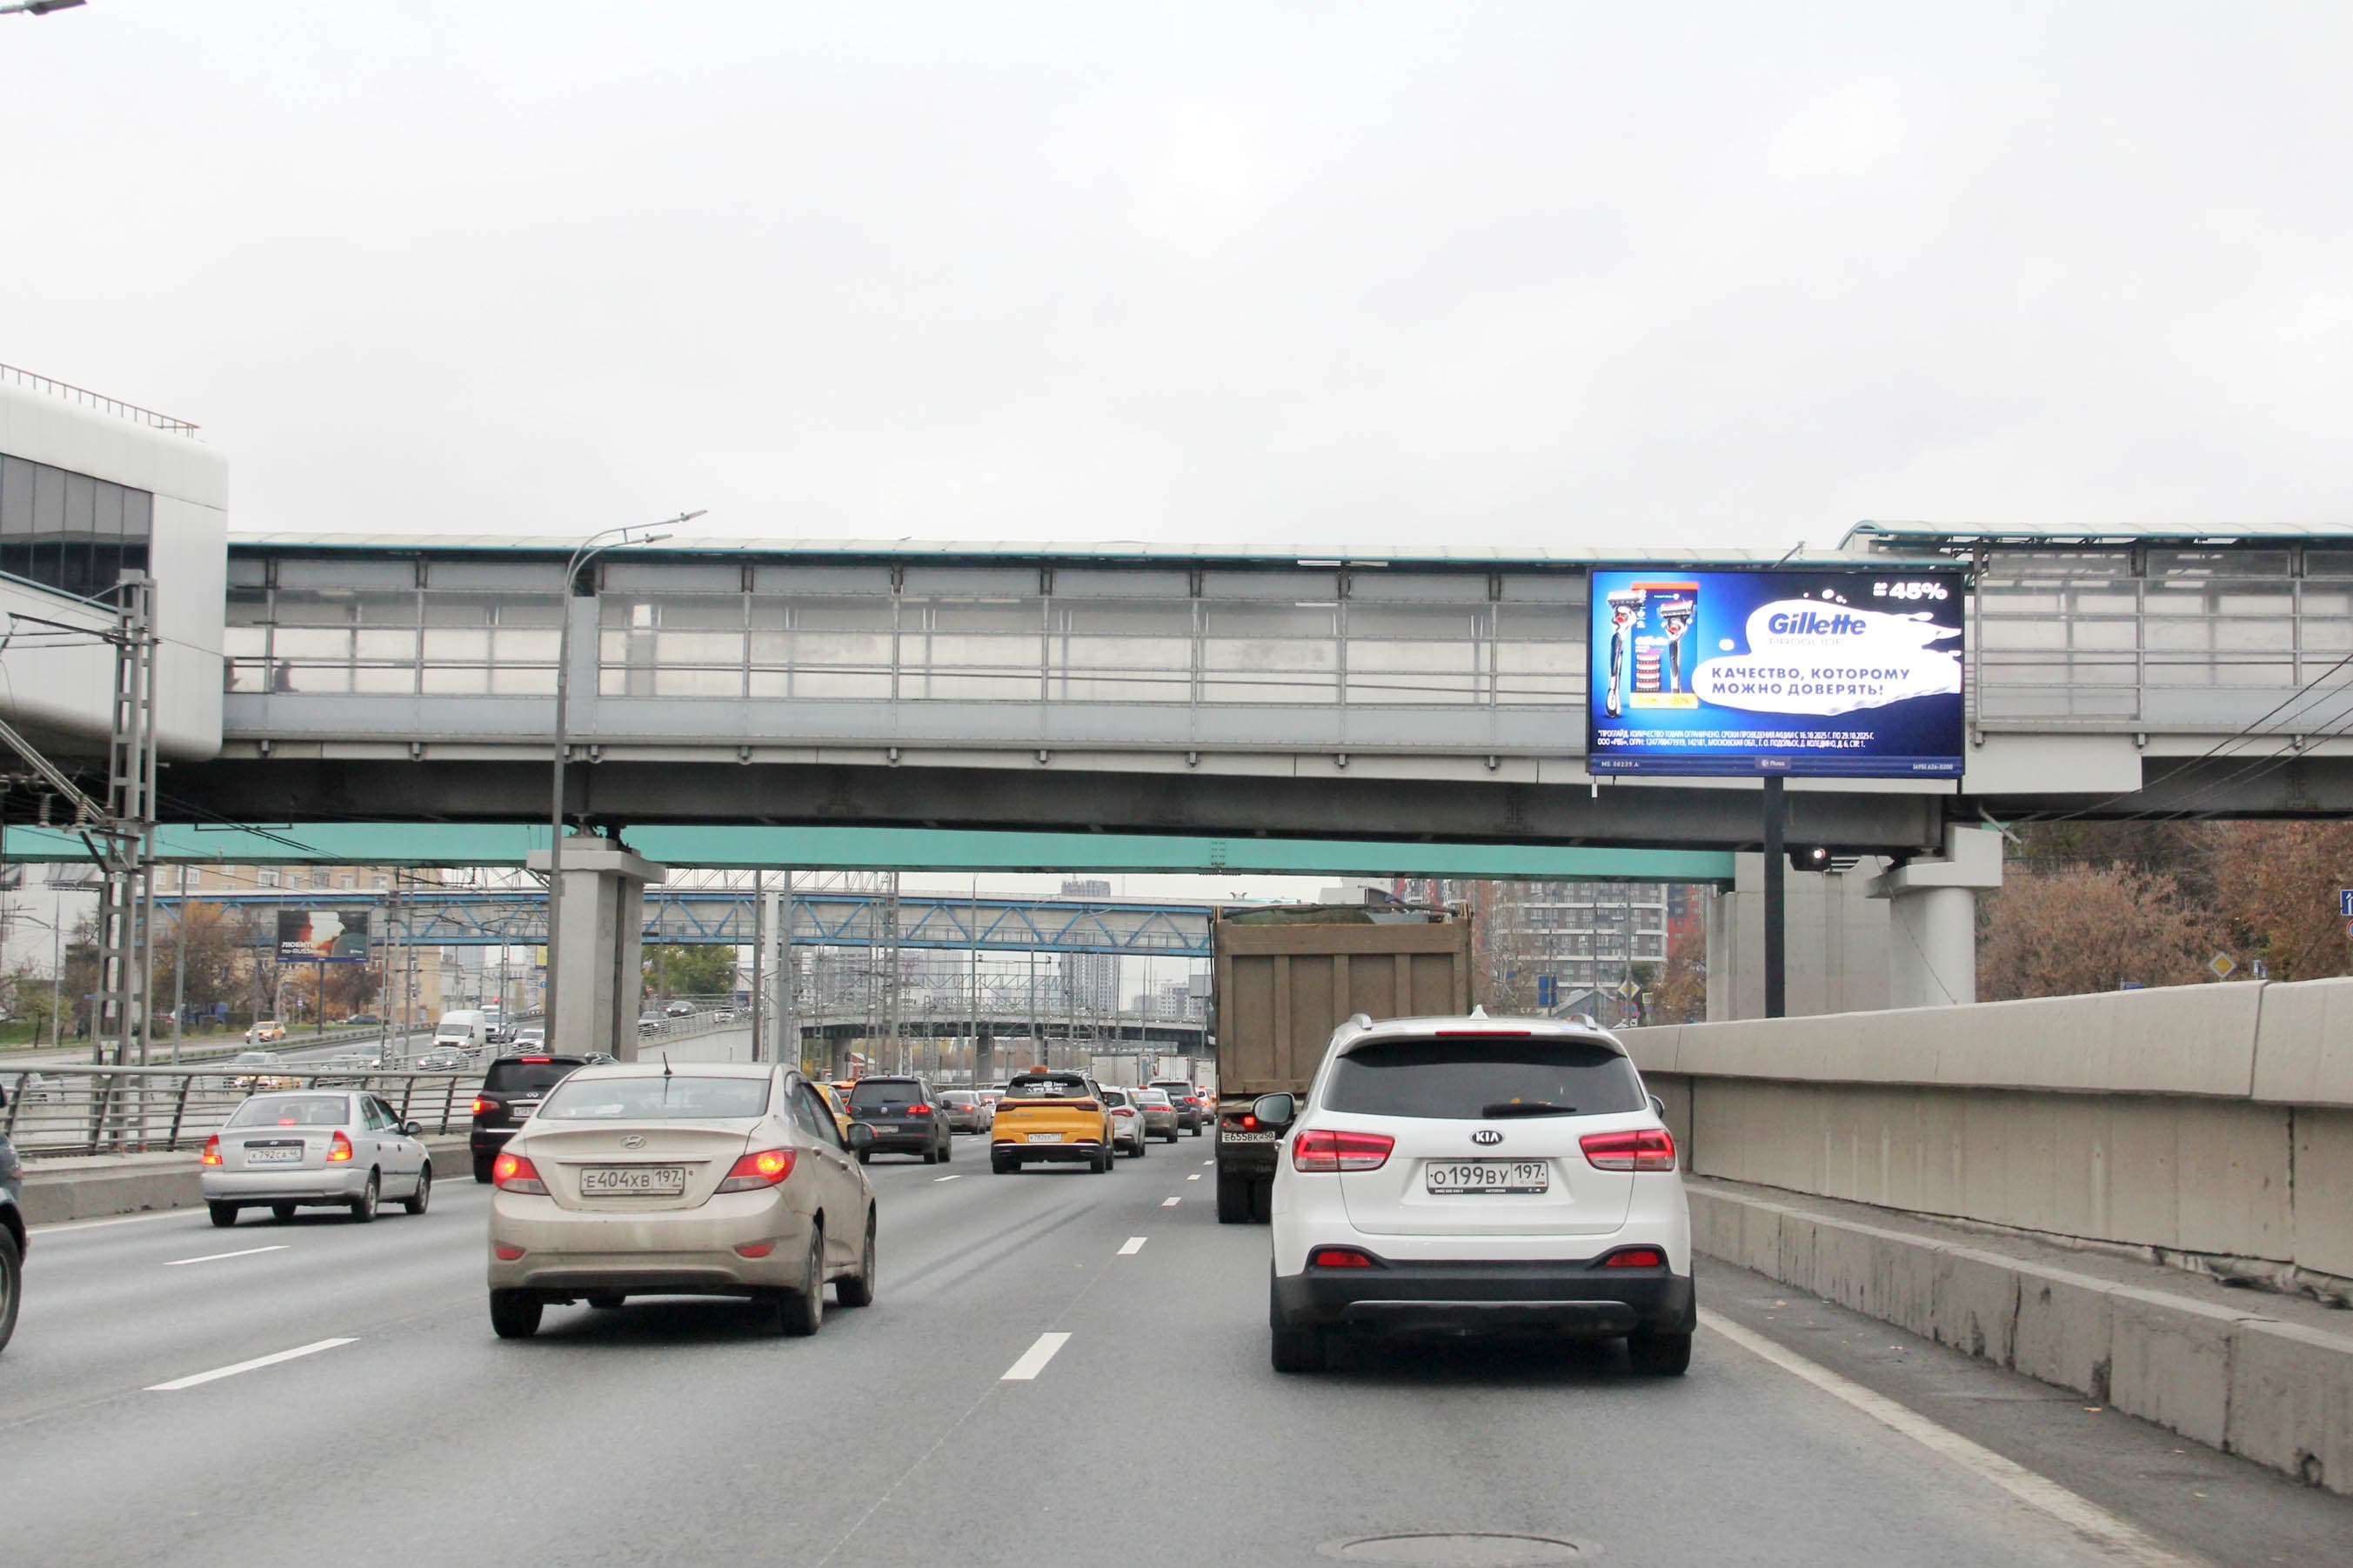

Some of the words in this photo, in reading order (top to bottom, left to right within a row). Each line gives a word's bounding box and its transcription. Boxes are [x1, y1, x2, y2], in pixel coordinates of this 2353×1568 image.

[1768, 611, 1867, 636] Gillette
[1711, 667, 1805, 681] КАЧЕСТВО,
[1811, 668, 1910, 680] КОТОРОМУ
[1712, 683, 1782, 695] МОЖНО
[1788, 684, 1884, 697] ДОВЕРЯТЬ!
[1224, 1132, 1259, 1141] Е655ВК
[1475, 1131, 1500, 1143] KIA
[586, 1171, 651, 1188] Е404ХВ
[654, 1170, 679, 1183] 197
[1434, 1166, 1508, 1184] О199ВУ
[1514, 1164, 1542, 1179] 197
